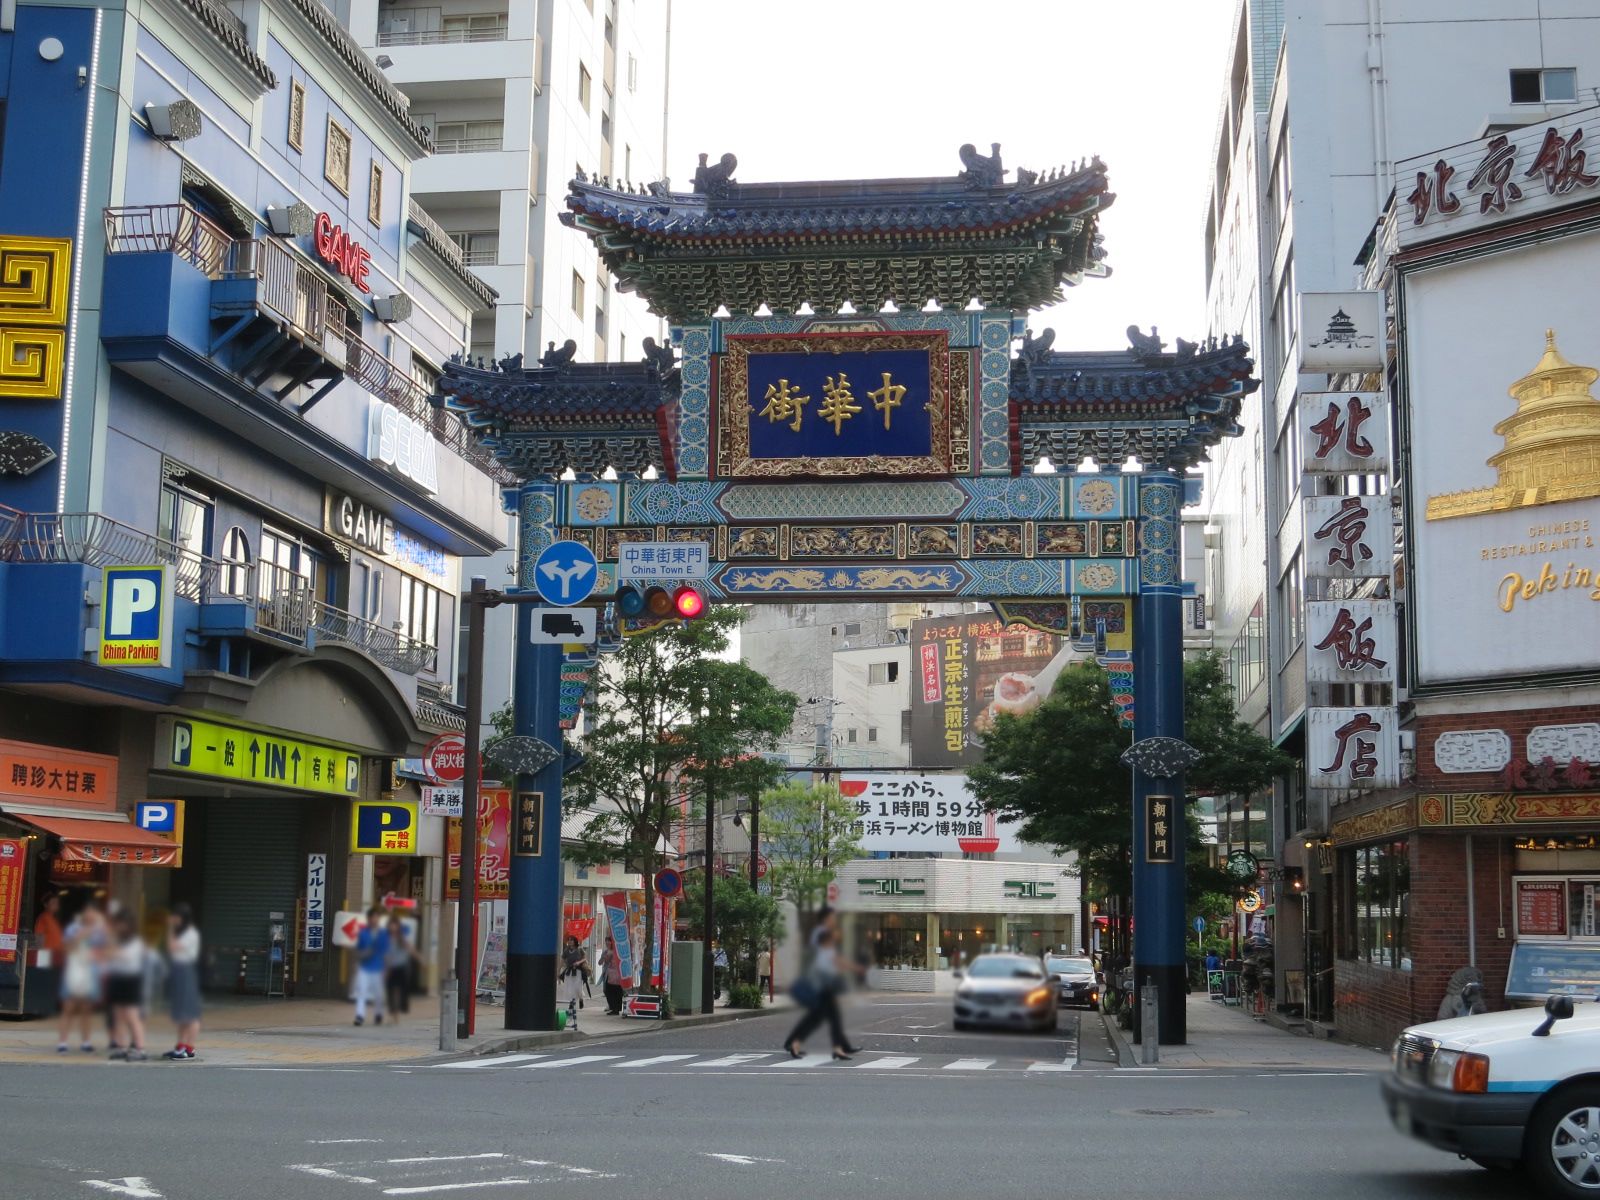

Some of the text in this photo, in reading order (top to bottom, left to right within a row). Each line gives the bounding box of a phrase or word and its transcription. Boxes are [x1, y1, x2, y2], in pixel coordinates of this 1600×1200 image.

[314, 212, 371, 294] GAME
[378, 402, 438, 495] SEGA
[341, 496, 393, 555] GAME
[1528, 519, 1589, 537] CHINESE
[625, 547, 702, 564] 中華街東門
[1481, 535, 1594, 560] RESTAURANT &
[631, 565, 695, 574] China Town E.
[110, 578, 157, 635] P
[103, 644, 159, 661] China Parking
[925, 650, 937, 699] 横浜名物
[944, 638, 963, 751] 正宗生煎包
[174, 723, 358, 791] P 一般 IN 有料 P
[12, 763, 96, 794] 聘珍大甘栗
[142, 805, 168, 828] P
[357, 805, 412, 849] P
[1152, 801, 1168, 854] 朝陽門
[385, 831, 409, 840] 一般
[385, 840, 409, 849] 有料
[308, 855, 325, 920] ハイルーフ車
[308, 926, 323, 949] 空車
